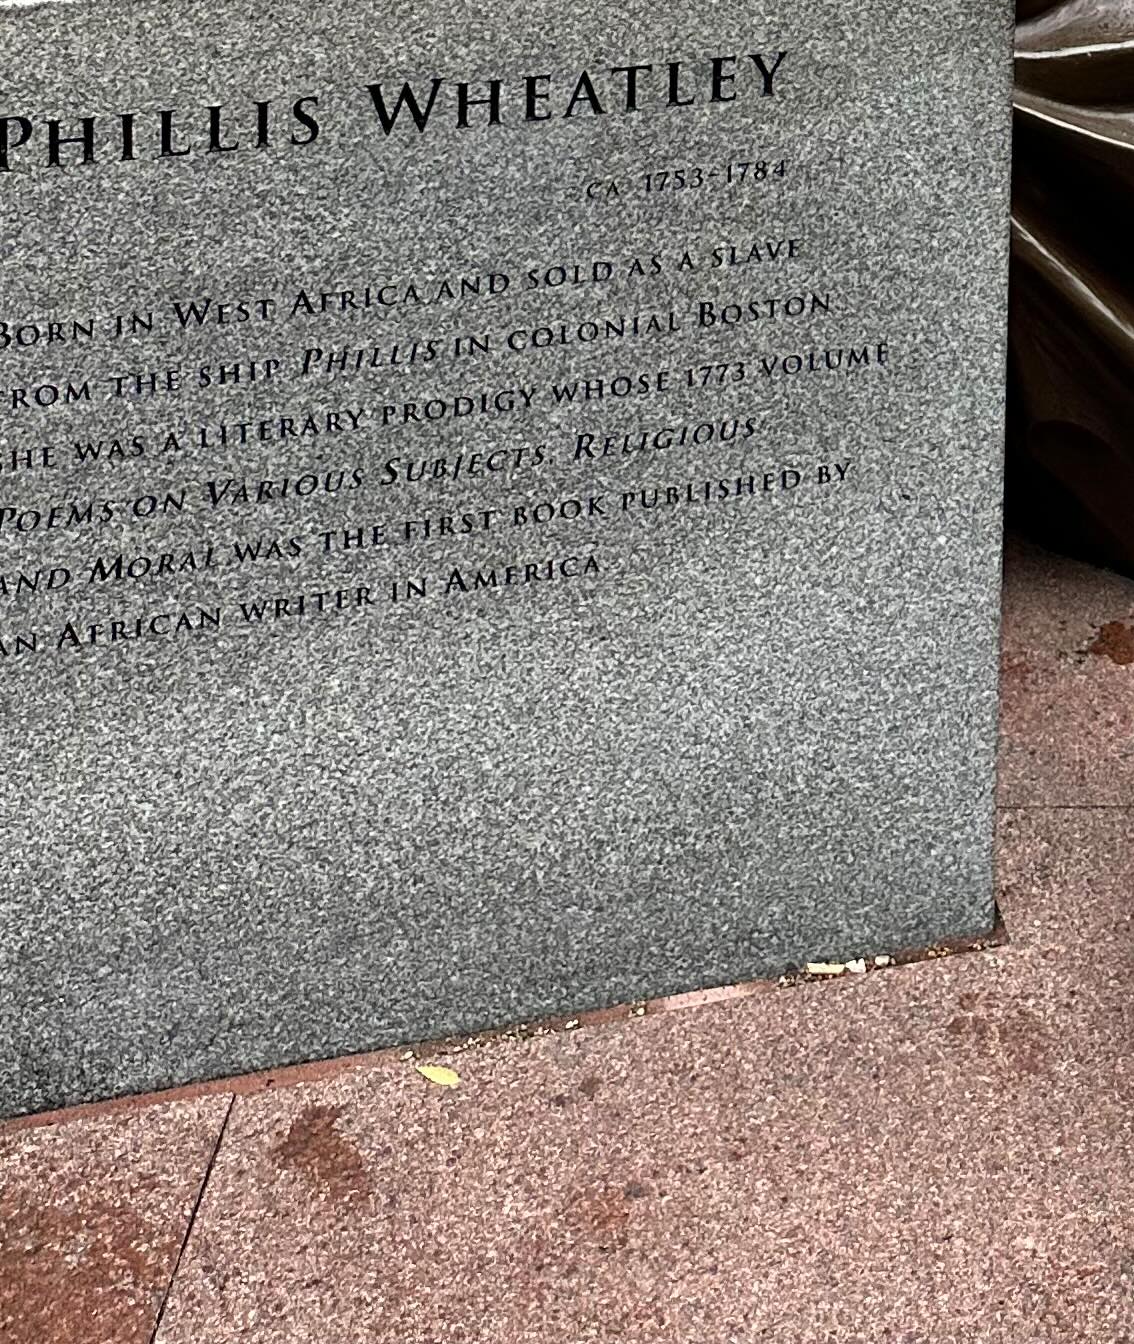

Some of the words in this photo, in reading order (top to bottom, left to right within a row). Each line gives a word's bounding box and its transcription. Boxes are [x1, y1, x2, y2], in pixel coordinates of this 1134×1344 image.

[0, 96, 320, 173] PHILLIS
[364, 51, 788, 137] WHEATLEY
[0, 318, 95, 349] BORN
[116, 312, 153, 337] IN
[172, 298, 275, 328] WEST
[292, 284, 421, 314] AFRICA
[437, 273, 511, 300] AND
[527, 261, 613, 290] SOLD
[628, 255, 662, 277] AS
[678, 251, 695, 272] A
[711, 239, 801, 268] SLAVE
[0, 381, 92, 409] ROM
[110, 370, 181, 397] THE
[199, 359, 281, 388] SHIP
[301, 339, 442, 375] PHILLIS
[454, 334, 490, 358] IN
[507, 312, 681, 351] COLONIAL
[699, 293, 831, 328] BOSTON
[0, 445, 57, 471] HE
[75, 435, 145, 462] WAS
[163, 432, 182, 453] A
[200, 408, 364, 449] LITERARY
[383, 387, 537, 425] PRODIGY
[552, 372, 669, 404] WHOSE
[685, 362, 746, 388] 1773
[761, 343, 890, 378] VOLUME
[0, 501, 116, 533] POEMS
[132, 490, 187, 516] ON
[207, 468, 364, 508] VARIOUS
[573, 417, 757, 462] RELIGIOUS
[89, 547, 217, 584] MORAL
[232, 537, 302, 563] WAS
[319, 523, 387, 553] THE
[405, 511, 500, 541] FIRST
[514, 496, 605, 526] BOOK
[622, 469, 801, 511] PUBLISHED
[817, 462, 850, 485] BY
[57, 607, 221, 649] AFRICAN
[240, 587, 374, 622] WRITER
[391, 577, 426, 603] IN
[445, 556, 600, 594] AMERICA
